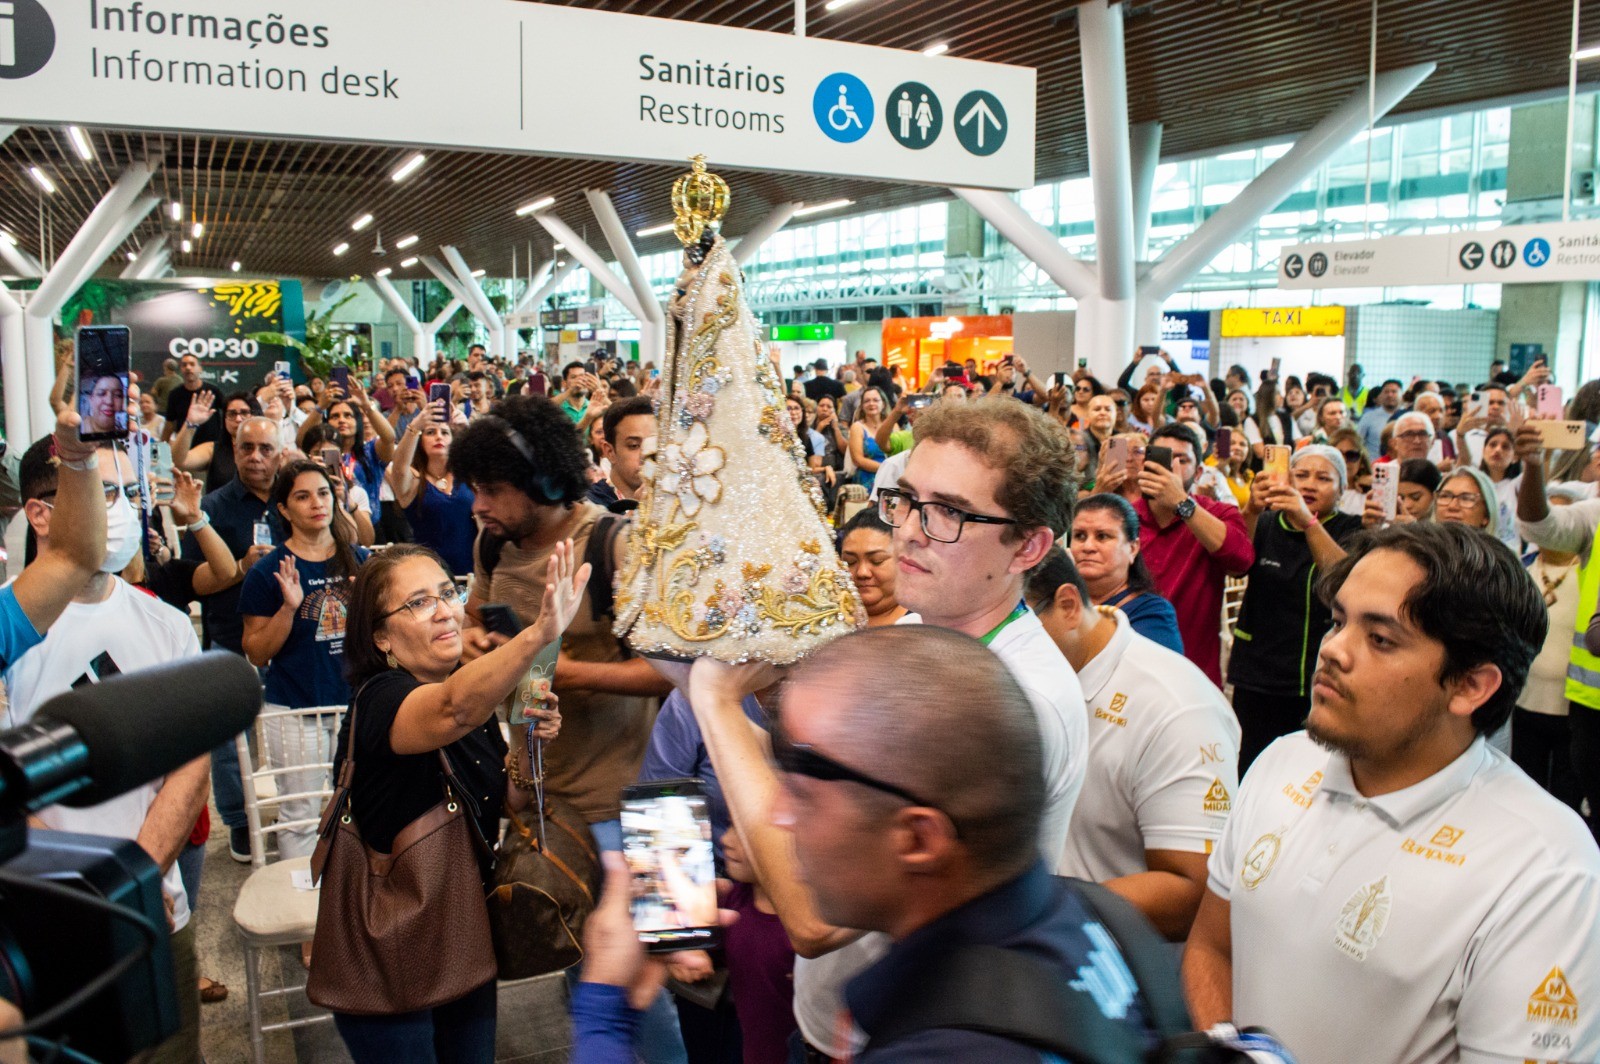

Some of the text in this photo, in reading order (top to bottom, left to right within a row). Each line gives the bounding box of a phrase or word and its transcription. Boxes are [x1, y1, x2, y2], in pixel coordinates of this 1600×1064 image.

[91, 0, 329, 49] Informações
[92, 47, 400, 99] Information desk
[639, 54, 785, 94] Sanitários
[640, 95, 785, 133] Restrooms
[1559, 234, 1600, 248] Sanitá
[1335, 250, 1375, 260] Elevador
[1334, 265, 1370, 275] Elevator
[1263, 311, 1301, 325] TAXI
[169, 337, 259, 359] COP30
[1200, 743, 1225, 765] NC
[1549, 982, 1562, 996] M
[1531, 1032, 1571, 1049] 2024
